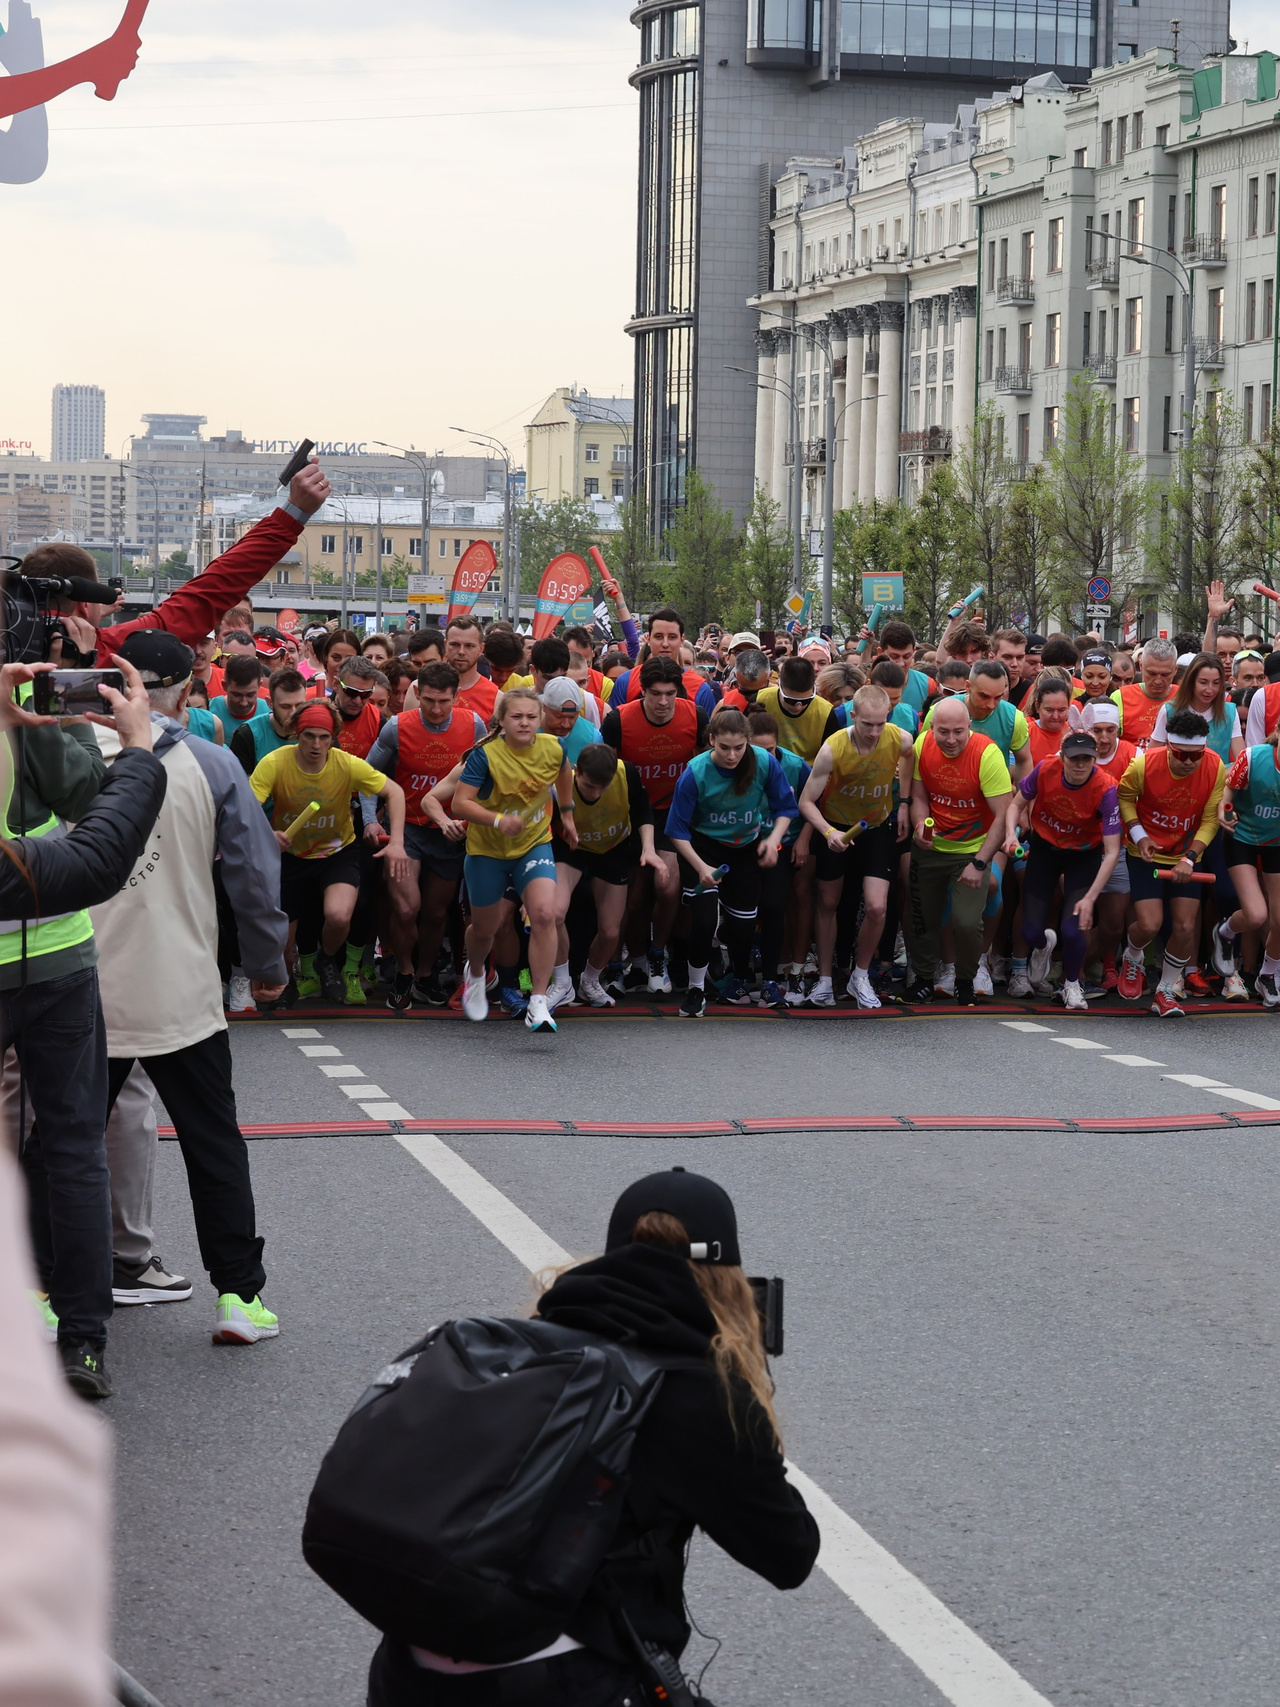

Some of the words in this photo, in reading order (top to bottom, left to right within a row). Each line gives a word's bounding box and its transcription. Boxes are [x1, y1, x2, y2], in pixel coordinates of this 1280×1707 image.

[0, 438, 31, 449] nk.ru
[252, 440, 300, 453] НИТУ
[314, 441, 369, 456] ИСИС
[461, 571, 486, 589] 0:59
[547, 580, 578, 601] 0:59
[839, 783, 889, 799] 421-01
[709, 808, 758, 825] 045-0
[1152, 811, 1197, 831] 223-01
